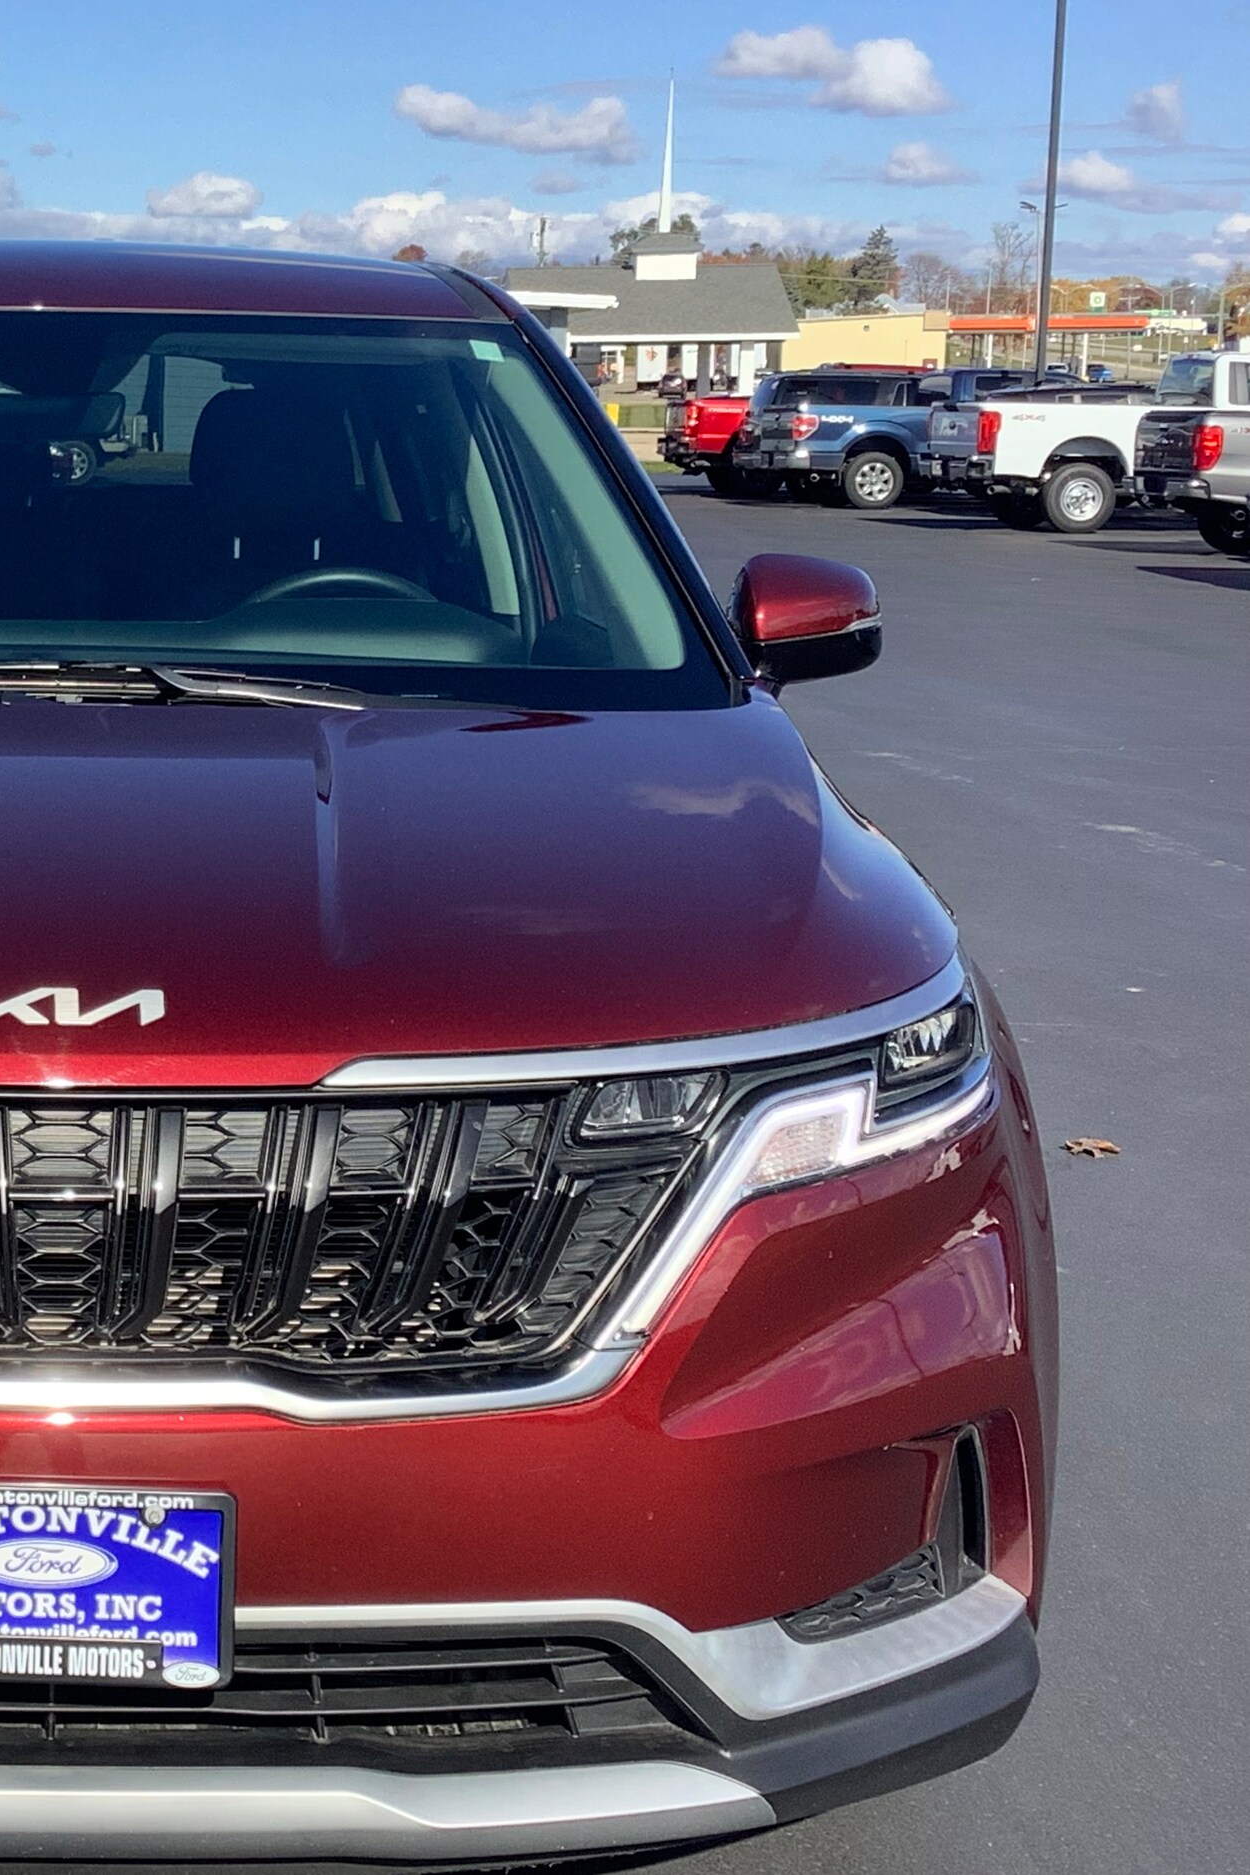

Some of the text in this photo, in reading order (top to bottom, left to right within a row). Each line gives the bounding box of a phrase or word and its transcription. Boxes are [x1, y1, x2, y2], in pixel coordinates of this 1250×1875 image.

[4, 1546, 83, 1576] Ford
[94, 1594, 163, 1622] INC
[67, 1646, 144, 1679] MOTORS
[175, 1666, 207, 1682] Ford
